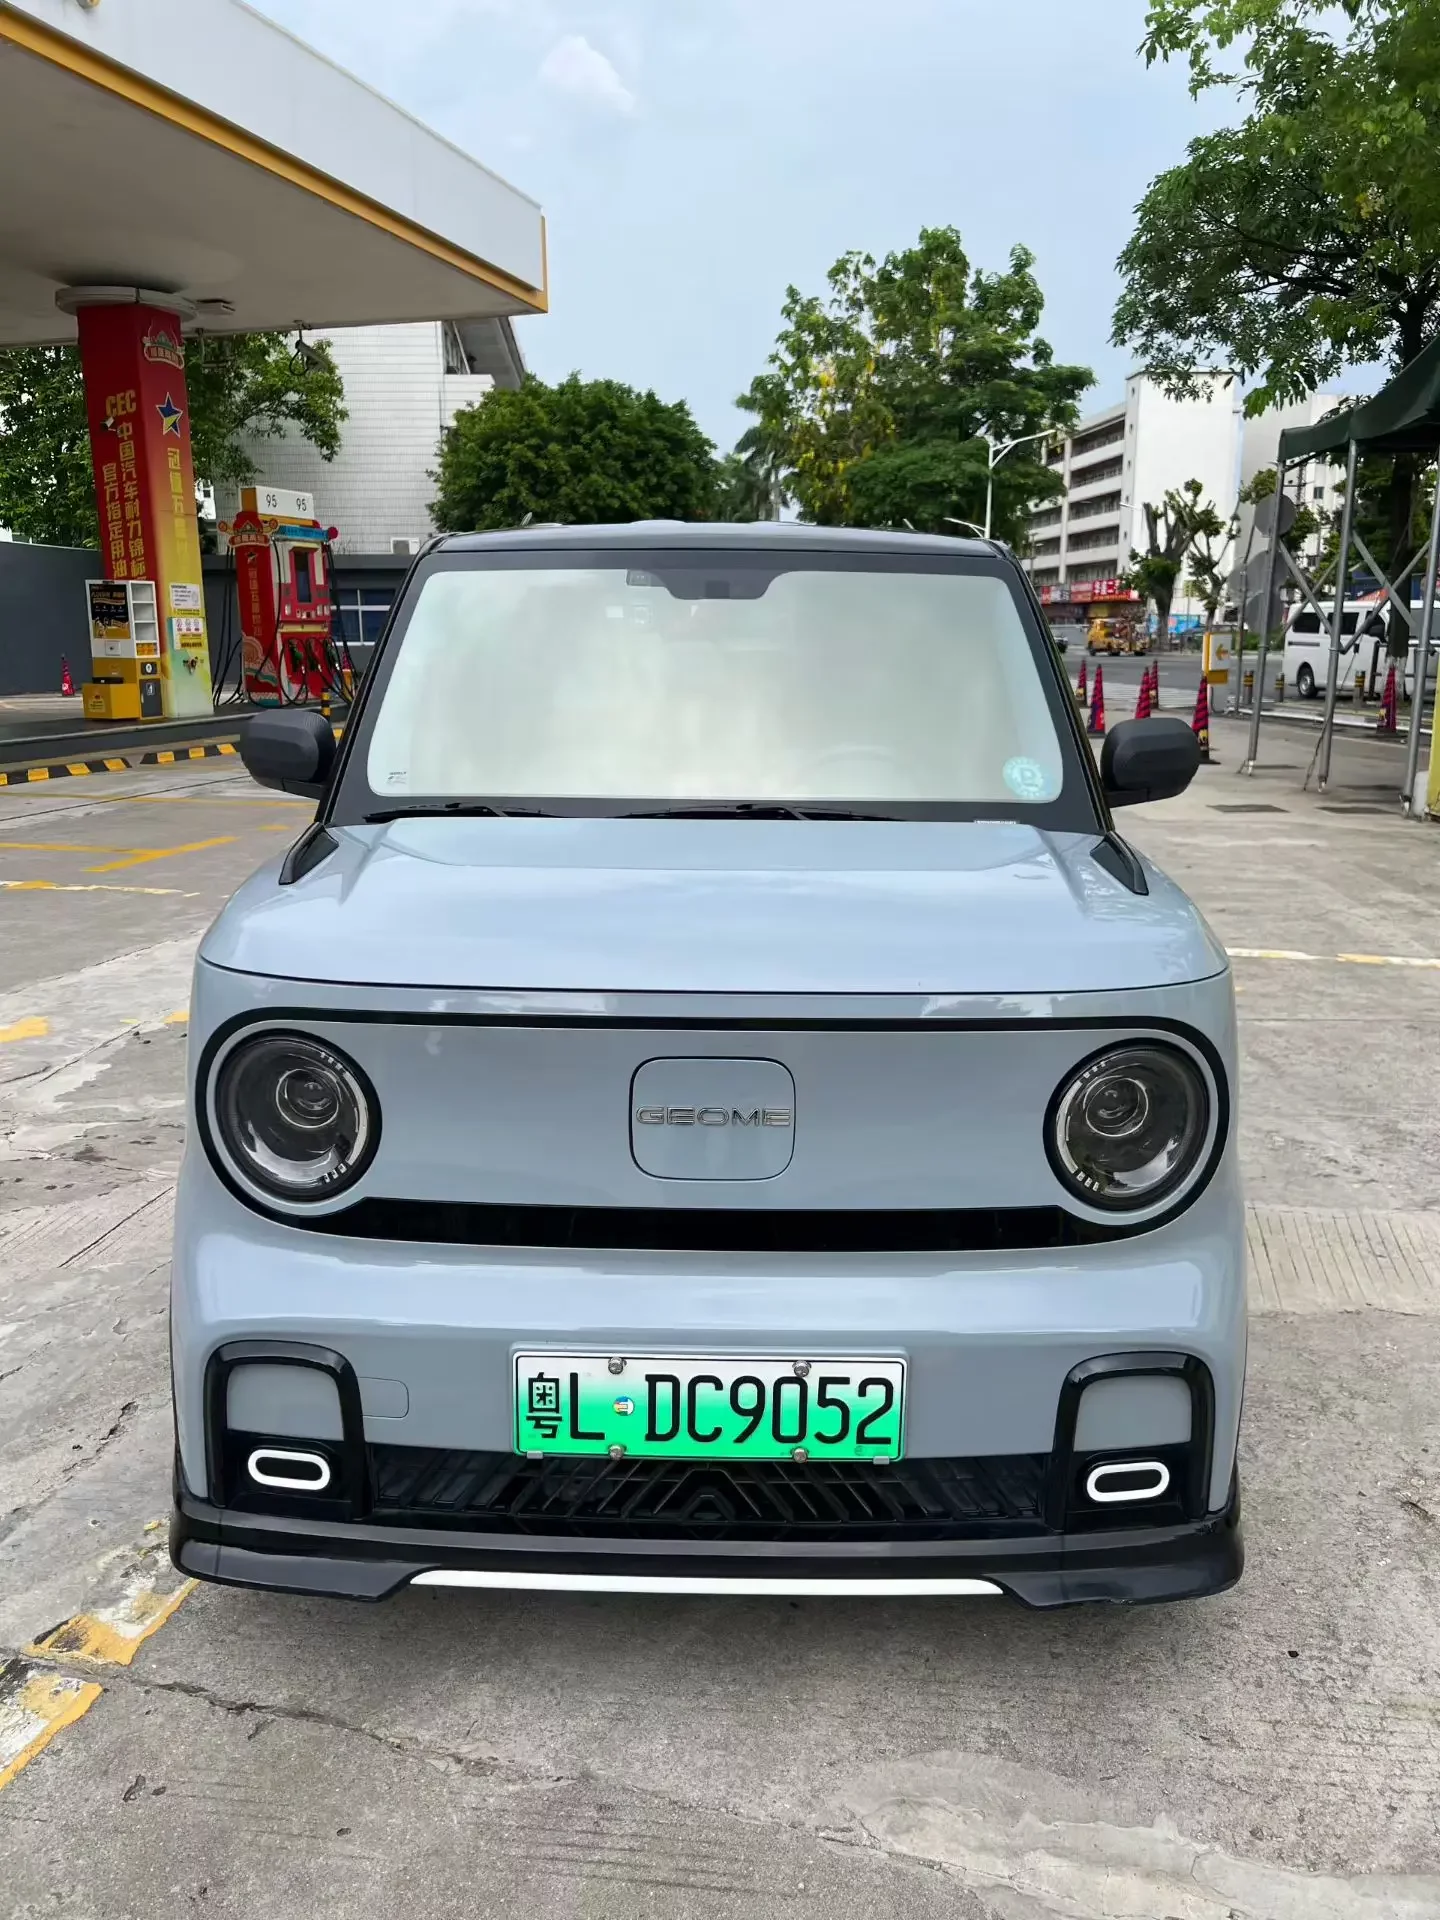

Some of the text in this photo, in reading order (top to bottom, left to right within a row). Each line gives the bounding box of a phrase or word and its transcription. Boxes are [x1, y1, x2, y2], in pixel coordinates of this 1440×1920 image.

[106, 390, 137, 417] CEC
[102, 463, 128, 580] 官方指定用油
[117, 422, 147, 580] 中国汽车耐力锦标
[266, 494, 307, 512] 95 95
[636, 1105, 791, 1127] GEOME
[525, 1371, 895, 1446] 粤L DC9052
